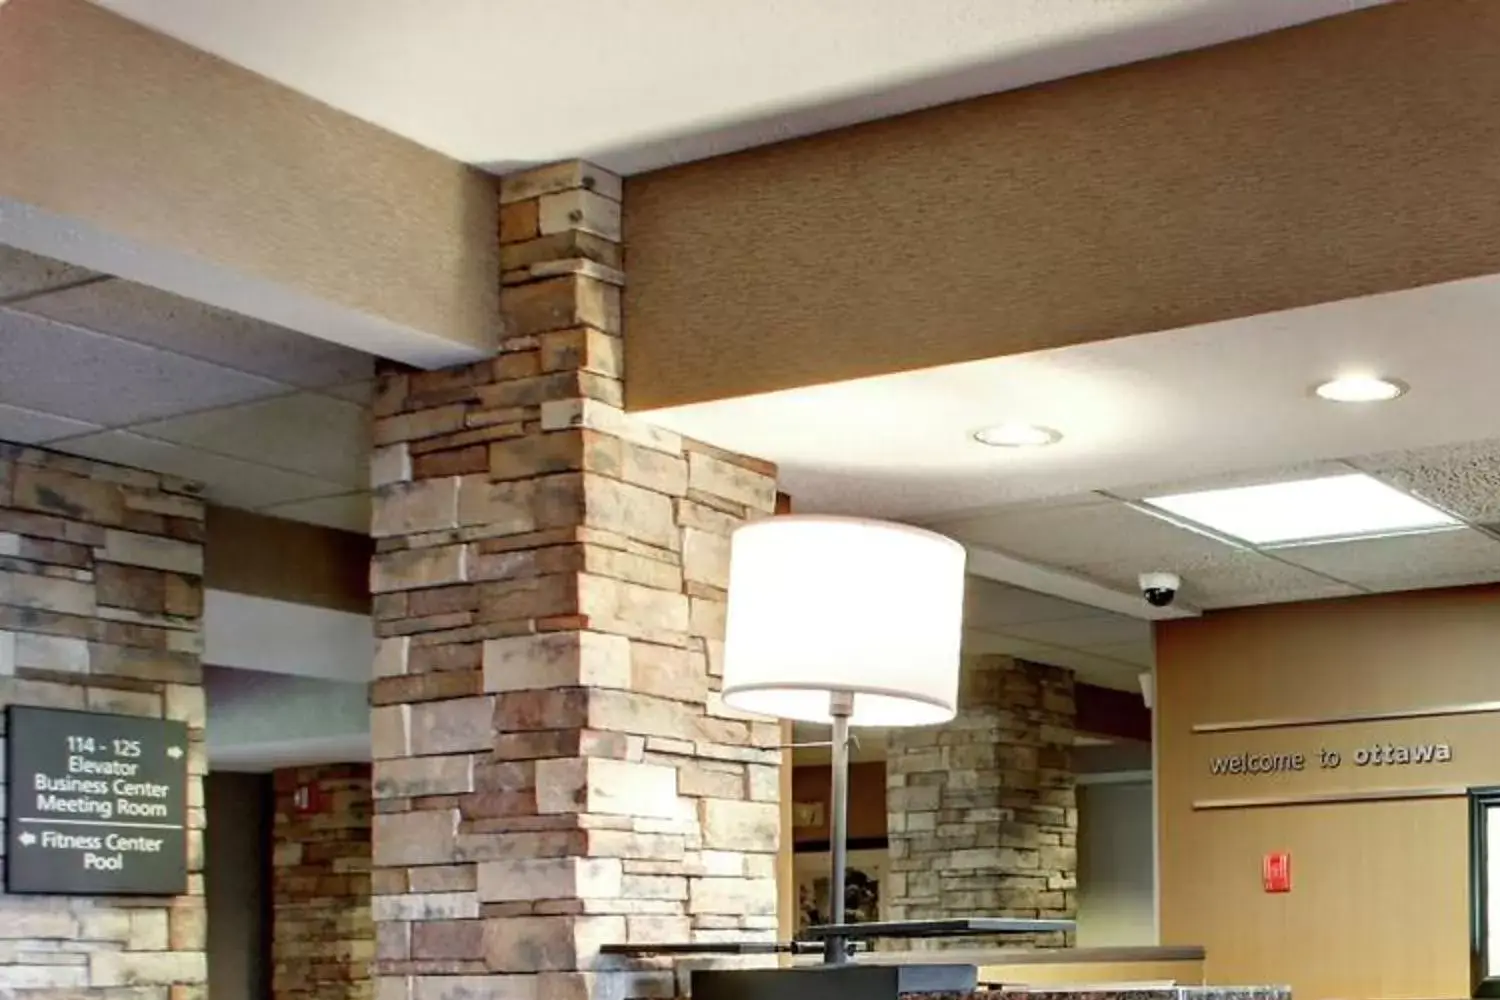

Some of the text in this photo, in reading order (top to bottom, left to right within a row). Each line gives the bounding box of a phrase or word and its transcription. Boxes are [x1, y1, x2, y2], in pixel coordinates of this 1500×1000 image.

[66, 736, 95, 753] 114
[113, 740, 141, 757] 125
[68, 756, 139, 776] Elevator
[1210, 742, 1453, 775] welcome to ottawa
[34, 773, 170, 798] Business Center
[36, 795, 168, 819] Meeting Room
[41, 831, 164, 853] Fitness Center
[83, 853, 124, 870] Pool
